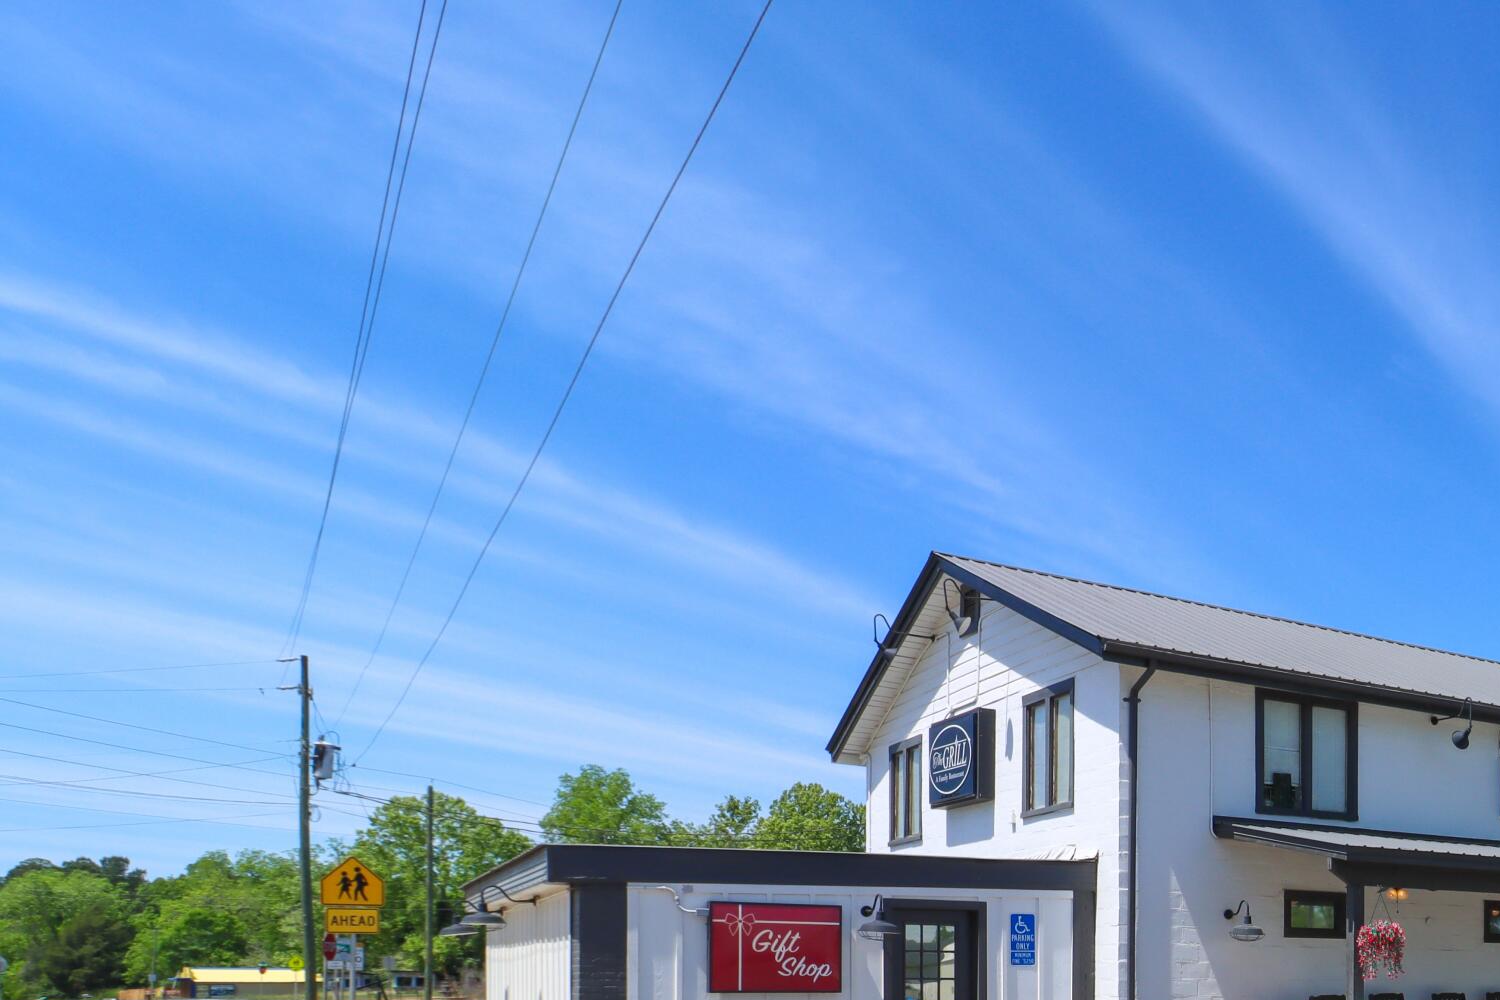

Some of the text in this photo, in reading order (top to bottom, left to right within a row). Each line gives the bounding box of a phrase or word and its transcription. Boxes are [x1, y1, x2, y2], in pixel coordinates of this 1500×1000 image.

[943, 735, 967, 769] GRILL
[331, 915, 376, 927] AHEAD
[752, 929, 801, 963] Gift
[1012, 934, 1034, 942] PARKING
[1016, 942, 1030, 950] ONLY
[778, 956, 832, 983] Shop
